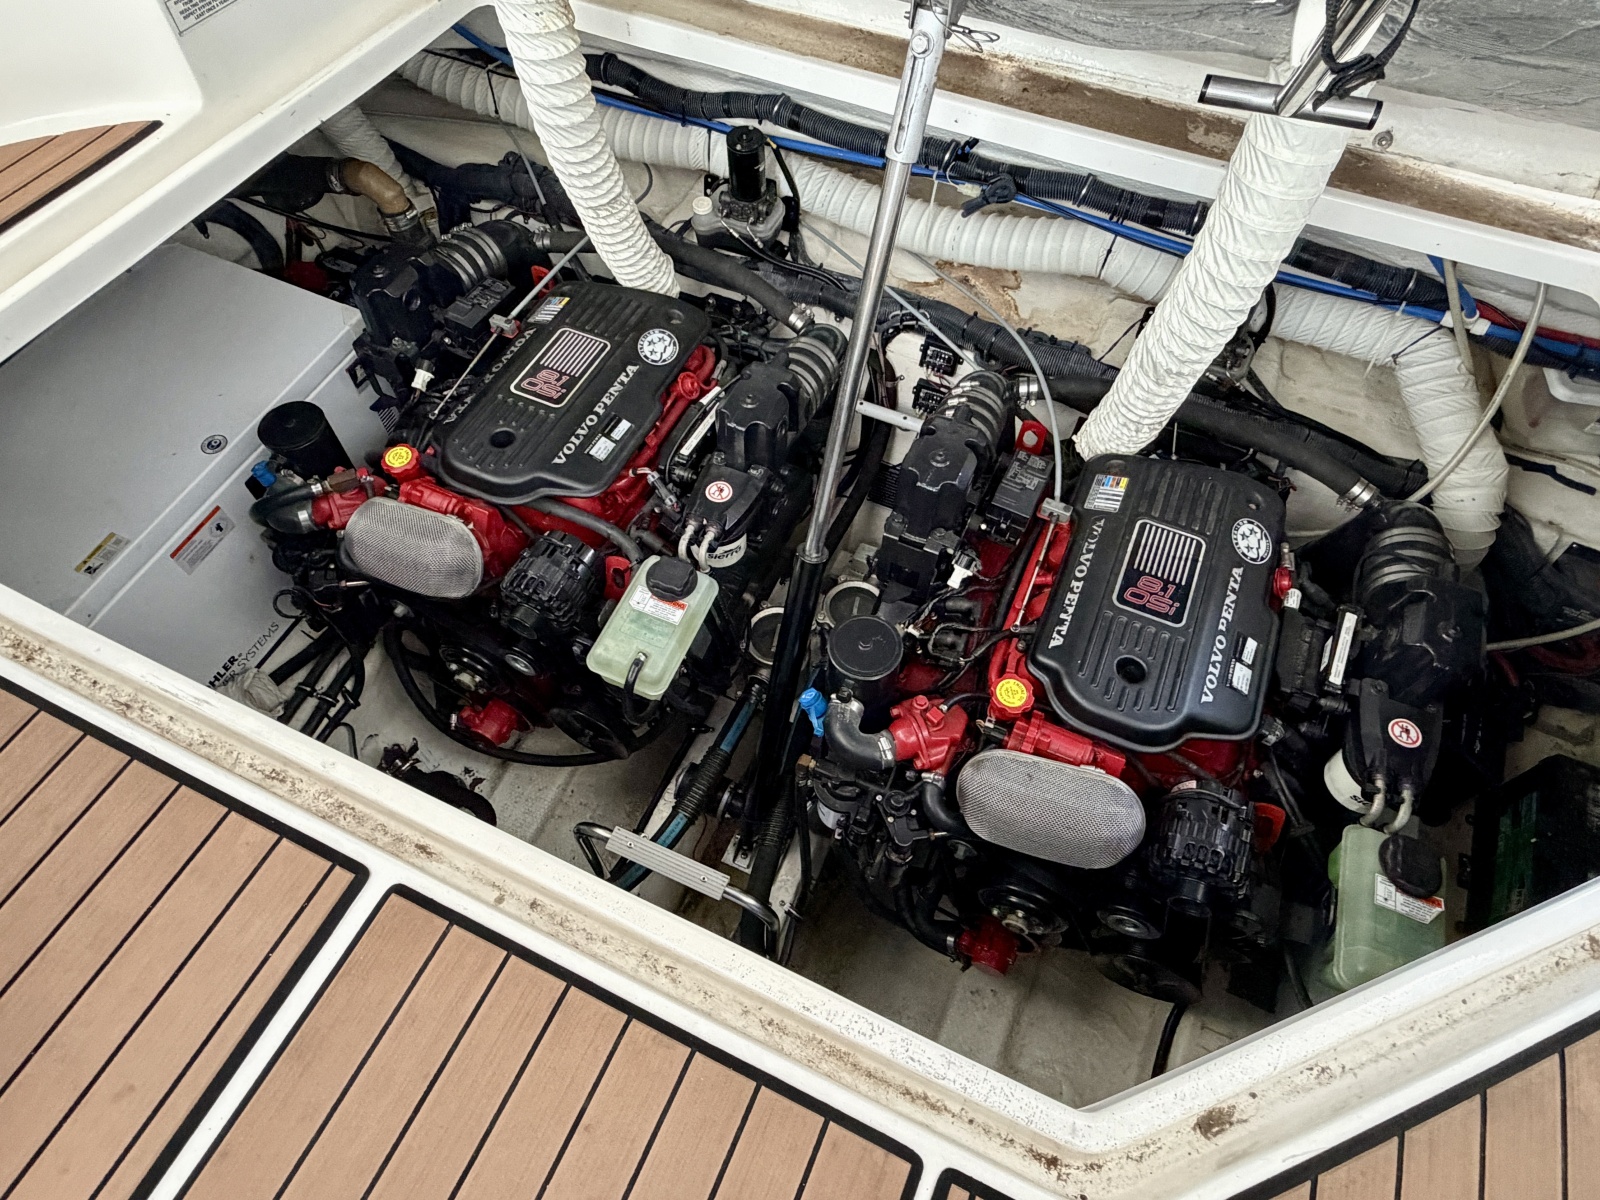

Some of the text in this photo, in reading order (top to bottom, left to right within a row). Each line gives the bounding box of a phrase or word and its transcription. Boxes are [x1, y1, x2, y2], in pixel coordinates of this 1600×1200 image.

[205, 4, 216, 13] ONCE
[537, 368, 570, 388] 8.1
[551, 413, 599, 465] VOLVO
[595, 363, 641, 416] PENTA
[1136, 575, 1177, 599] 8.1
[237, 621, 280, 670] SYSTEMS
[1199, 635, 1227, 704] VOLVO
[1217, 566, 1244, 633] PENTA
